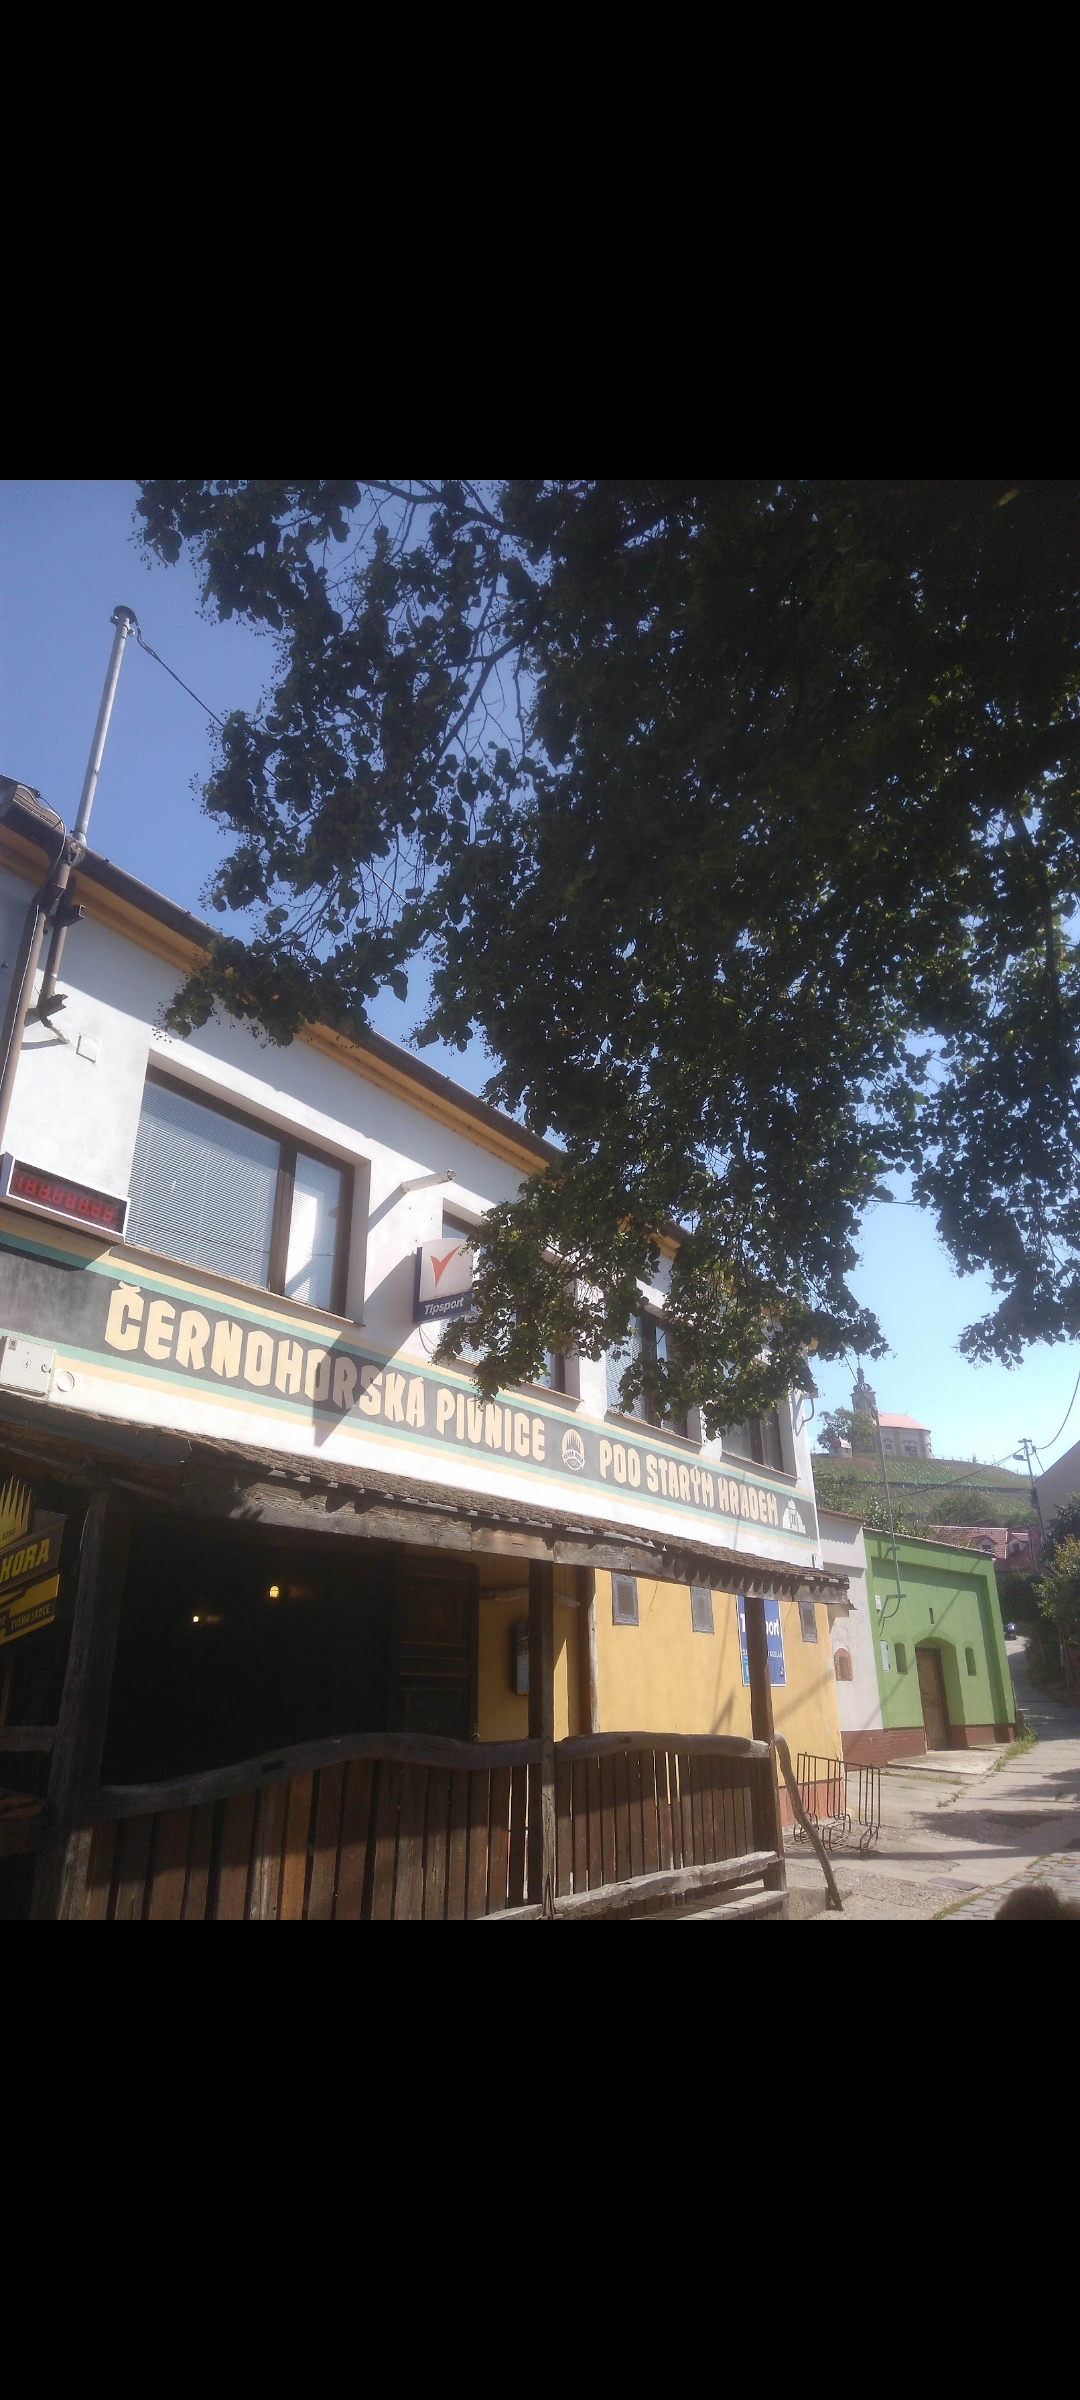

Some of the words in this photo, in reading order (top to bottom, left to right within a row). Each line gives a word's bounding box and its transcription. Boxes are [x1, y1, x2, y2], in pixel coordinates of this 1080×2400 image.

[424, 1297, 464, 1316] Tipsport
[105, 1280, 425, 1428] ČERNOHORSKÁ
[436, 1388, 546, 1461] PIVNICE
[599, 1439, 641, 1488] POD
[645, 1454, 715, 1509] STARÝM
[717, 1477, 779, 1526] HRADEM
[0, 1537, 51, 1583] HORA
